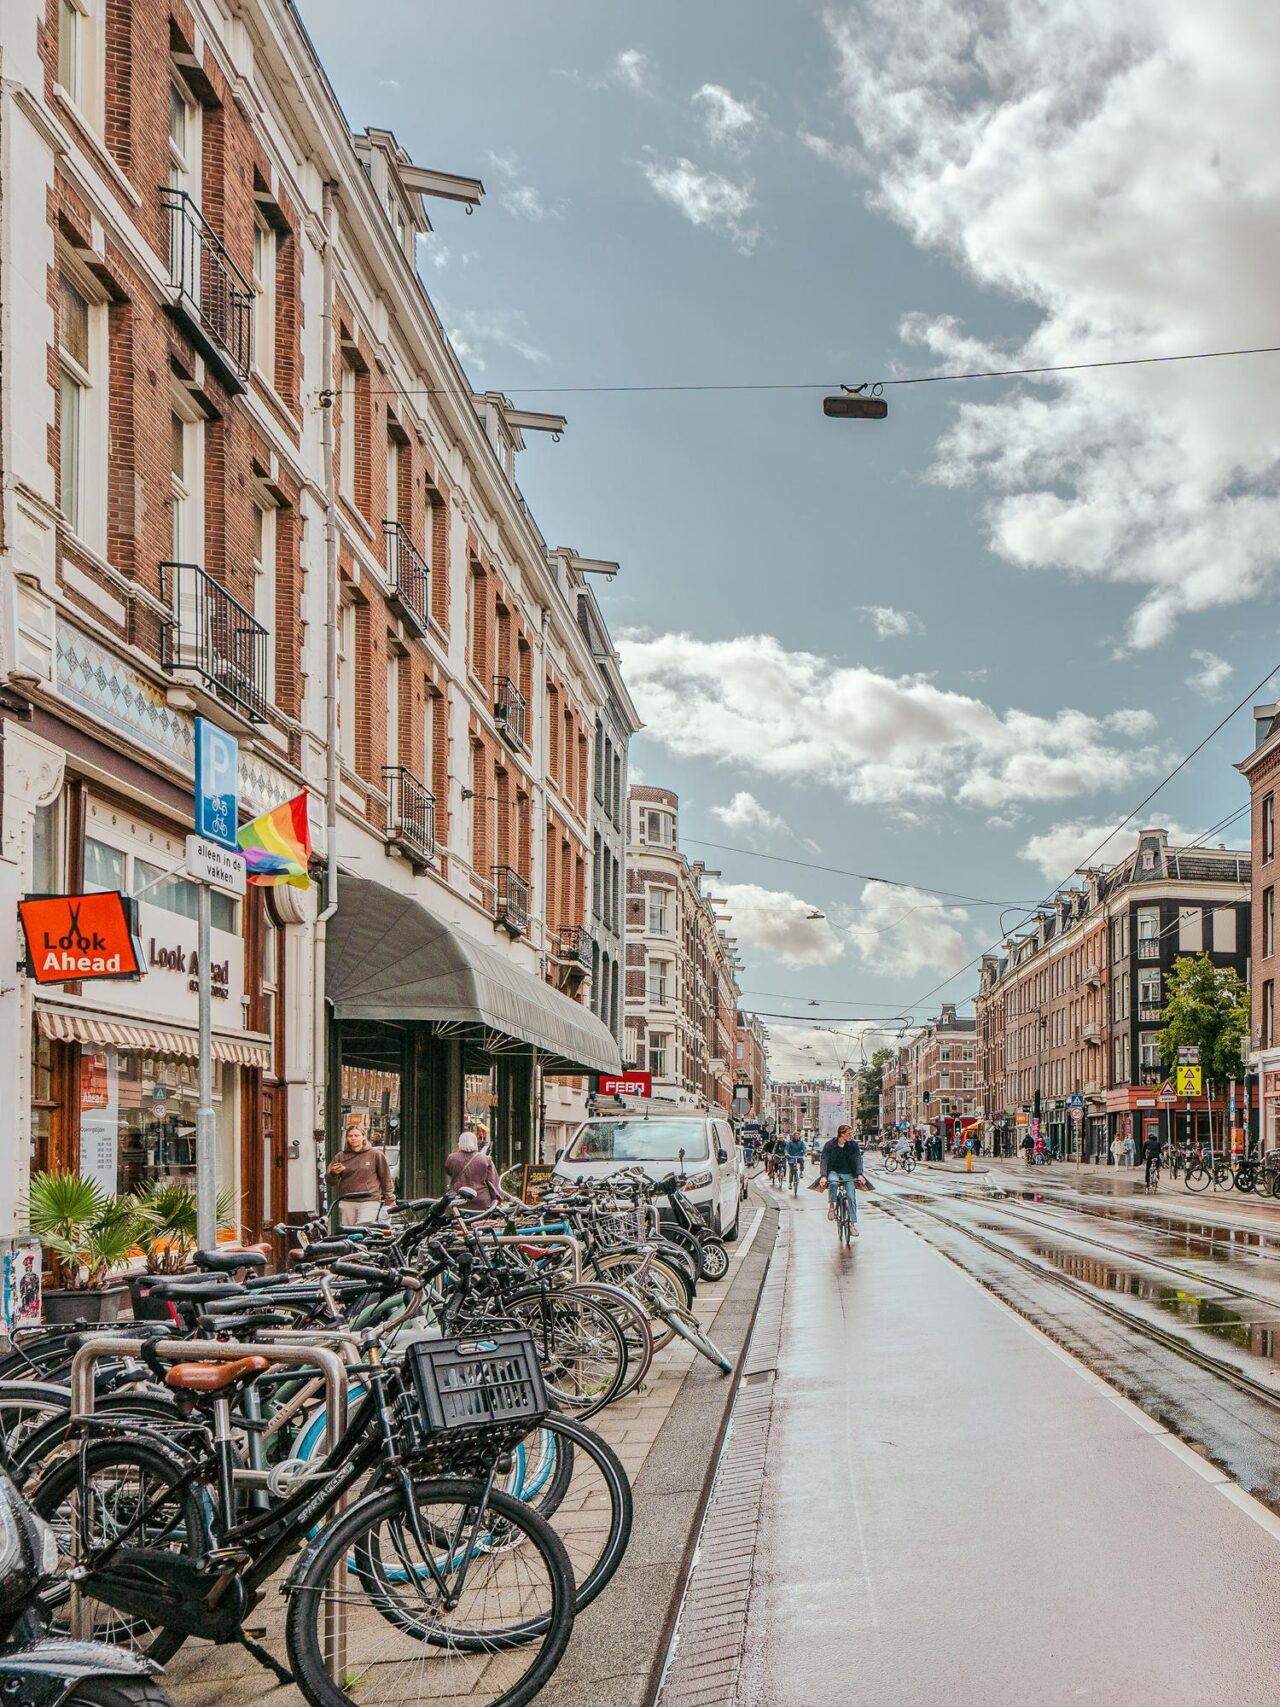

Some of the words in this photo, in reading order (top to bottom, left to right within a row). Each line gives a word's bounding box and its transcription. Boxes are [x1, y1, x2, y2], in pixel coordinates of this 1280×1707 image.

[209, 734, 230, 791] P
[197, 844, 221, 863] alleen
[223, 856, 231, 868] in
[233, 859, 242, 873] de
[206, 864, 234, 884] vakken
[43, 932, 107, 954] Look
[42, 952, 121, 972] Ahead
[150, 937, 186, 973] Look
[188, 950, 229, 985] Aad
[605, 1081, 646, 1093] FEBO
[297, 1488, 329, 1524] SPARTA
